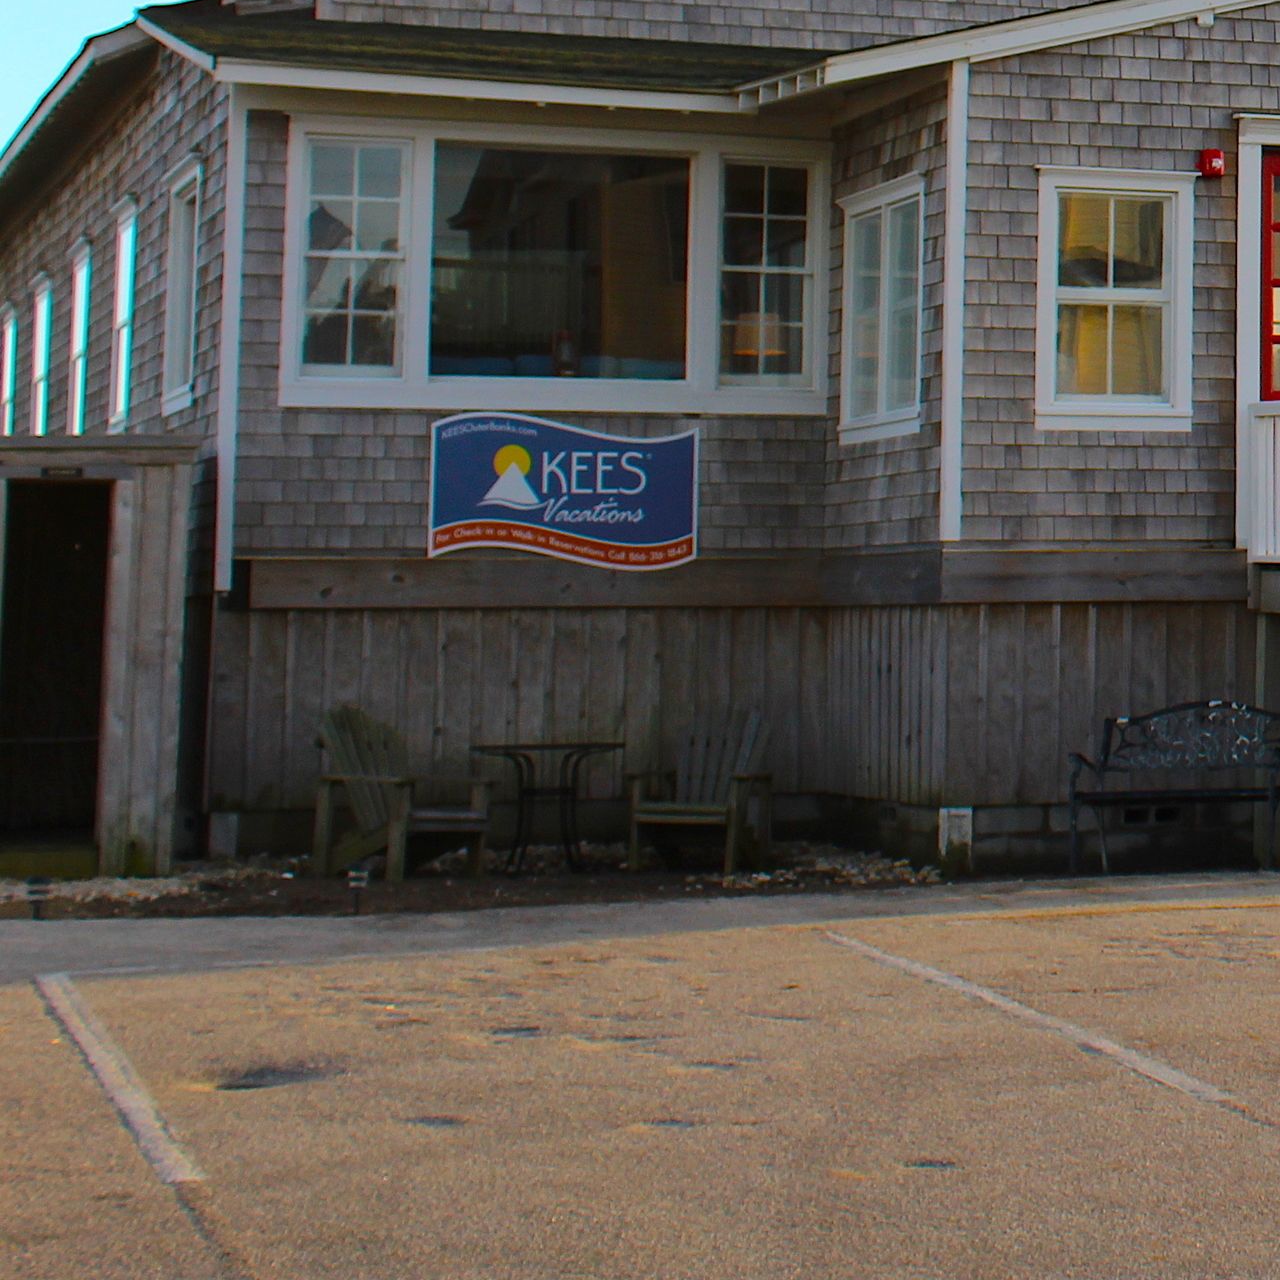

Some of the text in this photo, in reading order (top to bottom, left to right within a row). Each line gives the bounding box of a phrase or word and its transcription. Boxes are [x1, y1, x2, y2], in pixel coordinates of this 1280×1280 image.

[543, 495, 643, 523] Vacations
[436, 534, 449, 544] For
[549, 536, 605, 557] Reservations
[607, 547, 625, 560] Call
